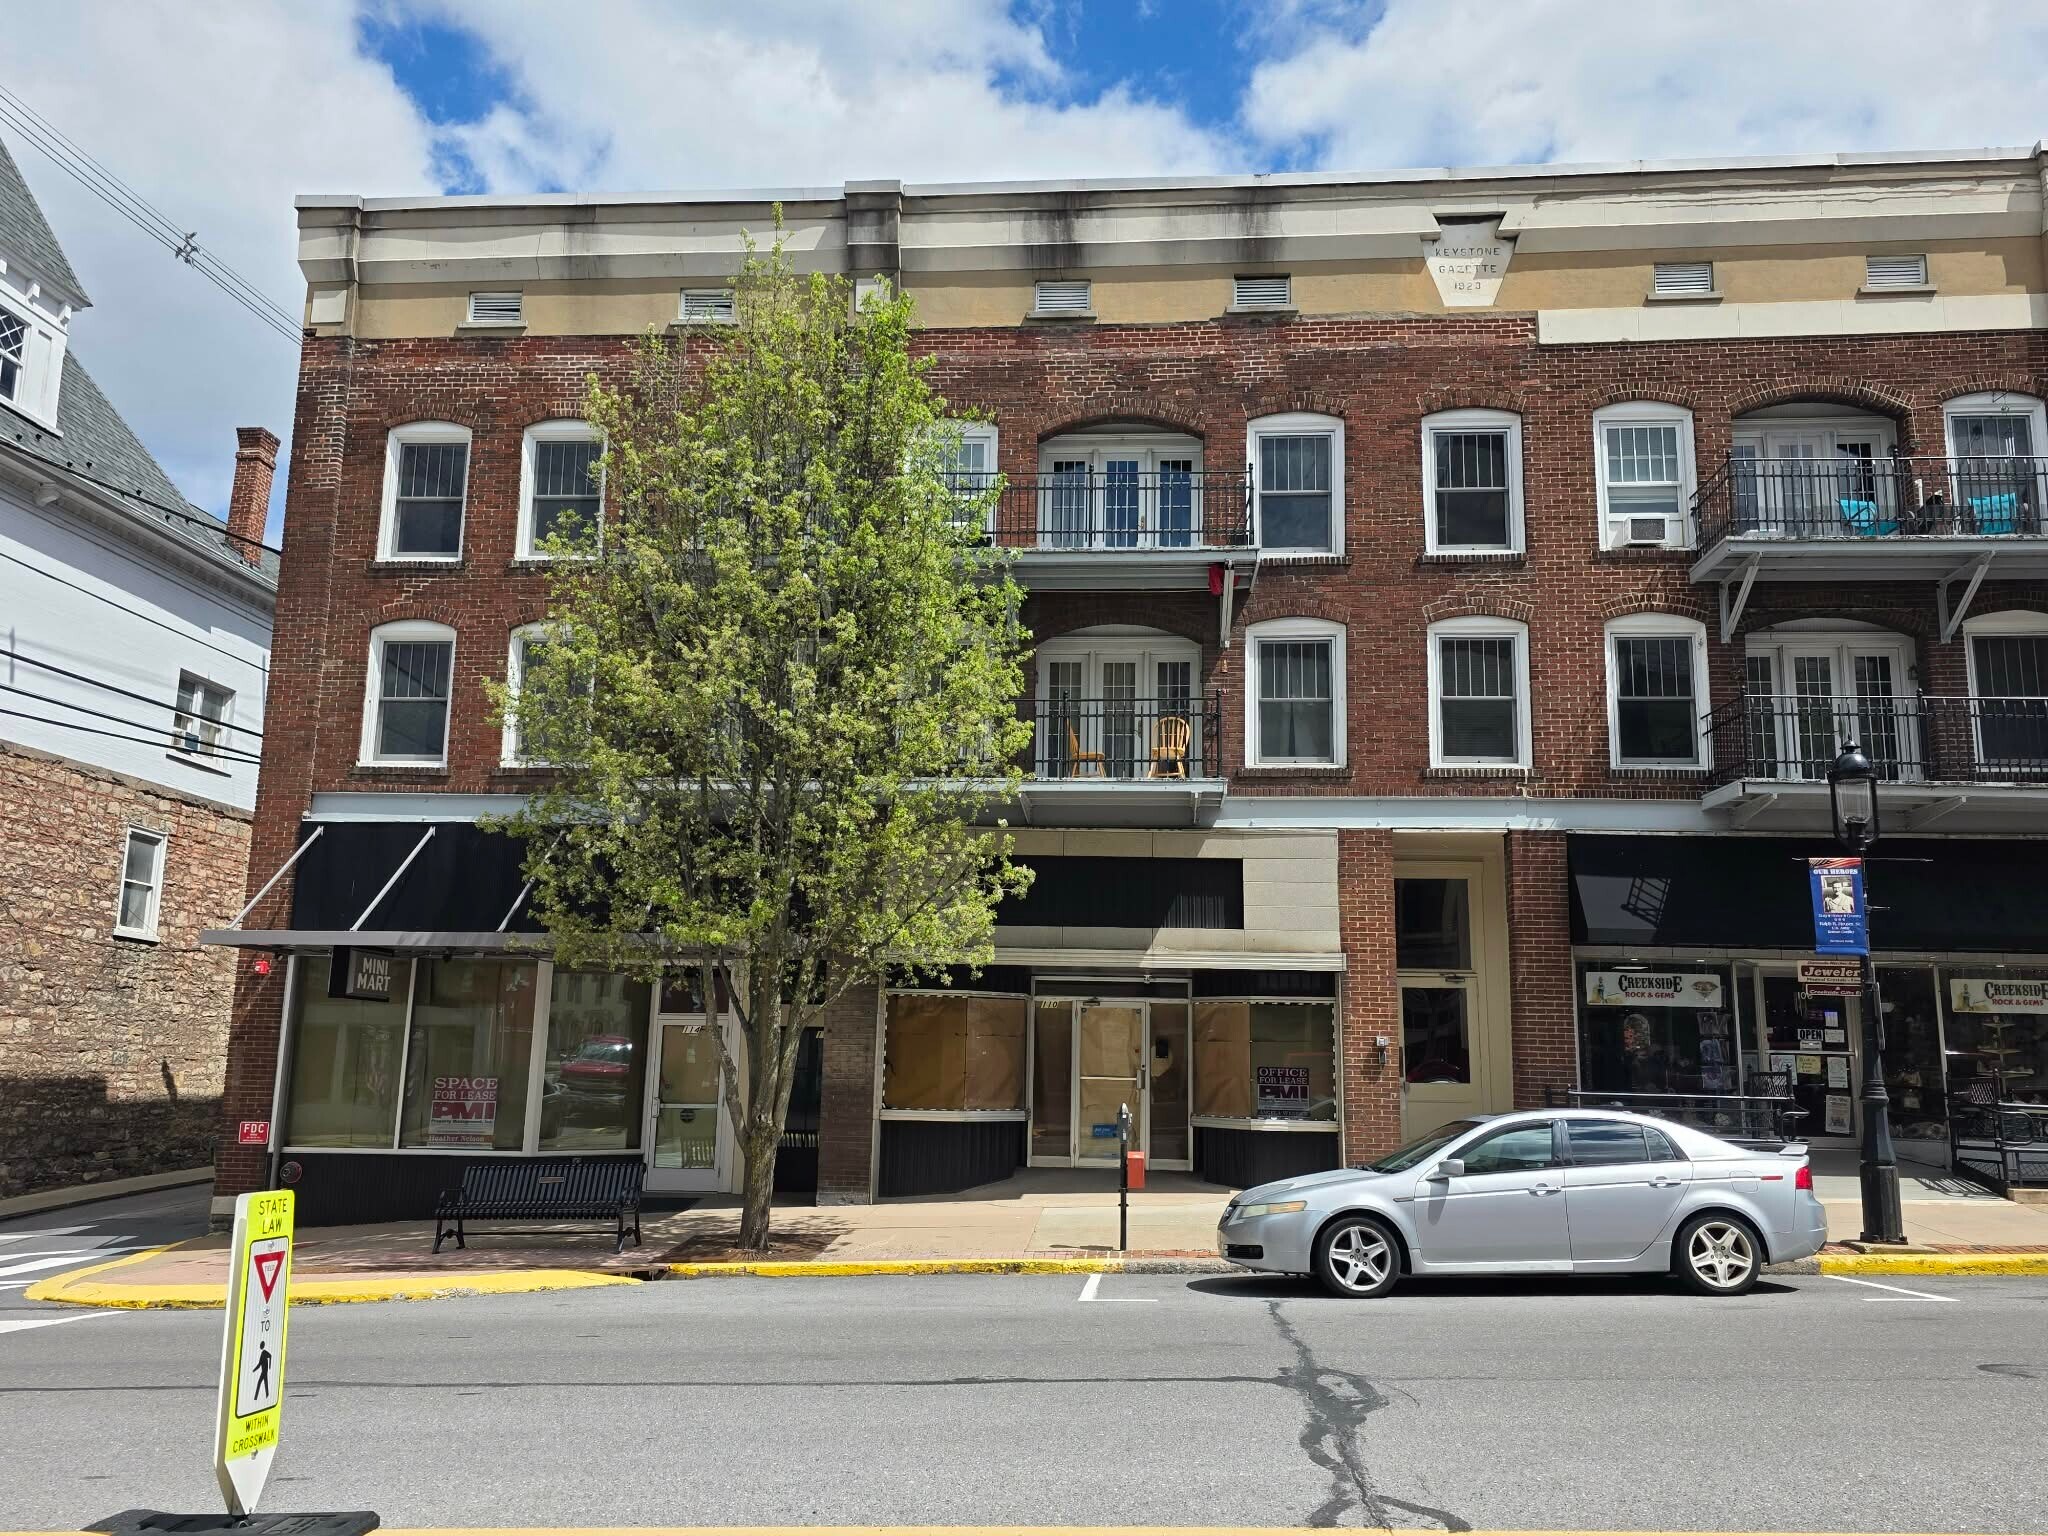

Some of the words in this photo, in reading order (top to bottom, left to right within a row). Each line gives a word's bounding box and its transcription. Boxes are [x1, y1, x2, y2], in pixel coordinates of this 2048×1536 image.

[1435, 247, 1500, 257] KEYSTONE
[1438, 264, 1497, 274] GAZETTE
[1454, 281, 1481, 291] 1923
[363, 957, 389, 976] MINI
[357, 973, 391, 992] MART
[1618, 975, 1682, 992] CREEKSIDE
[1984, 982, 2048, 1000] CREEKSIDE
[1992, 998, 2014, 1006] ROCK
[1800, 1029, 1822, 1040] OPEN
[1259, 1068, 1308, 1077] OFFICE
[434, 1077, 498, 1089] SPACE
[434, 1091, 457, 1100] FOR
[460, 1091, 497, 1100] LEASE
[433, 1102, 496, 1119] PMI
[243, 1123, 265, 1133] FDC
[258, 1198, 288, 1216] STATE
[262, 1219, 282, 1234] LAW
[261, 1320, 270, 1332] TO
[245, 1415, 269, 1432] WITHIN
[232, 1429, 275, 1453] CROSSWALK
